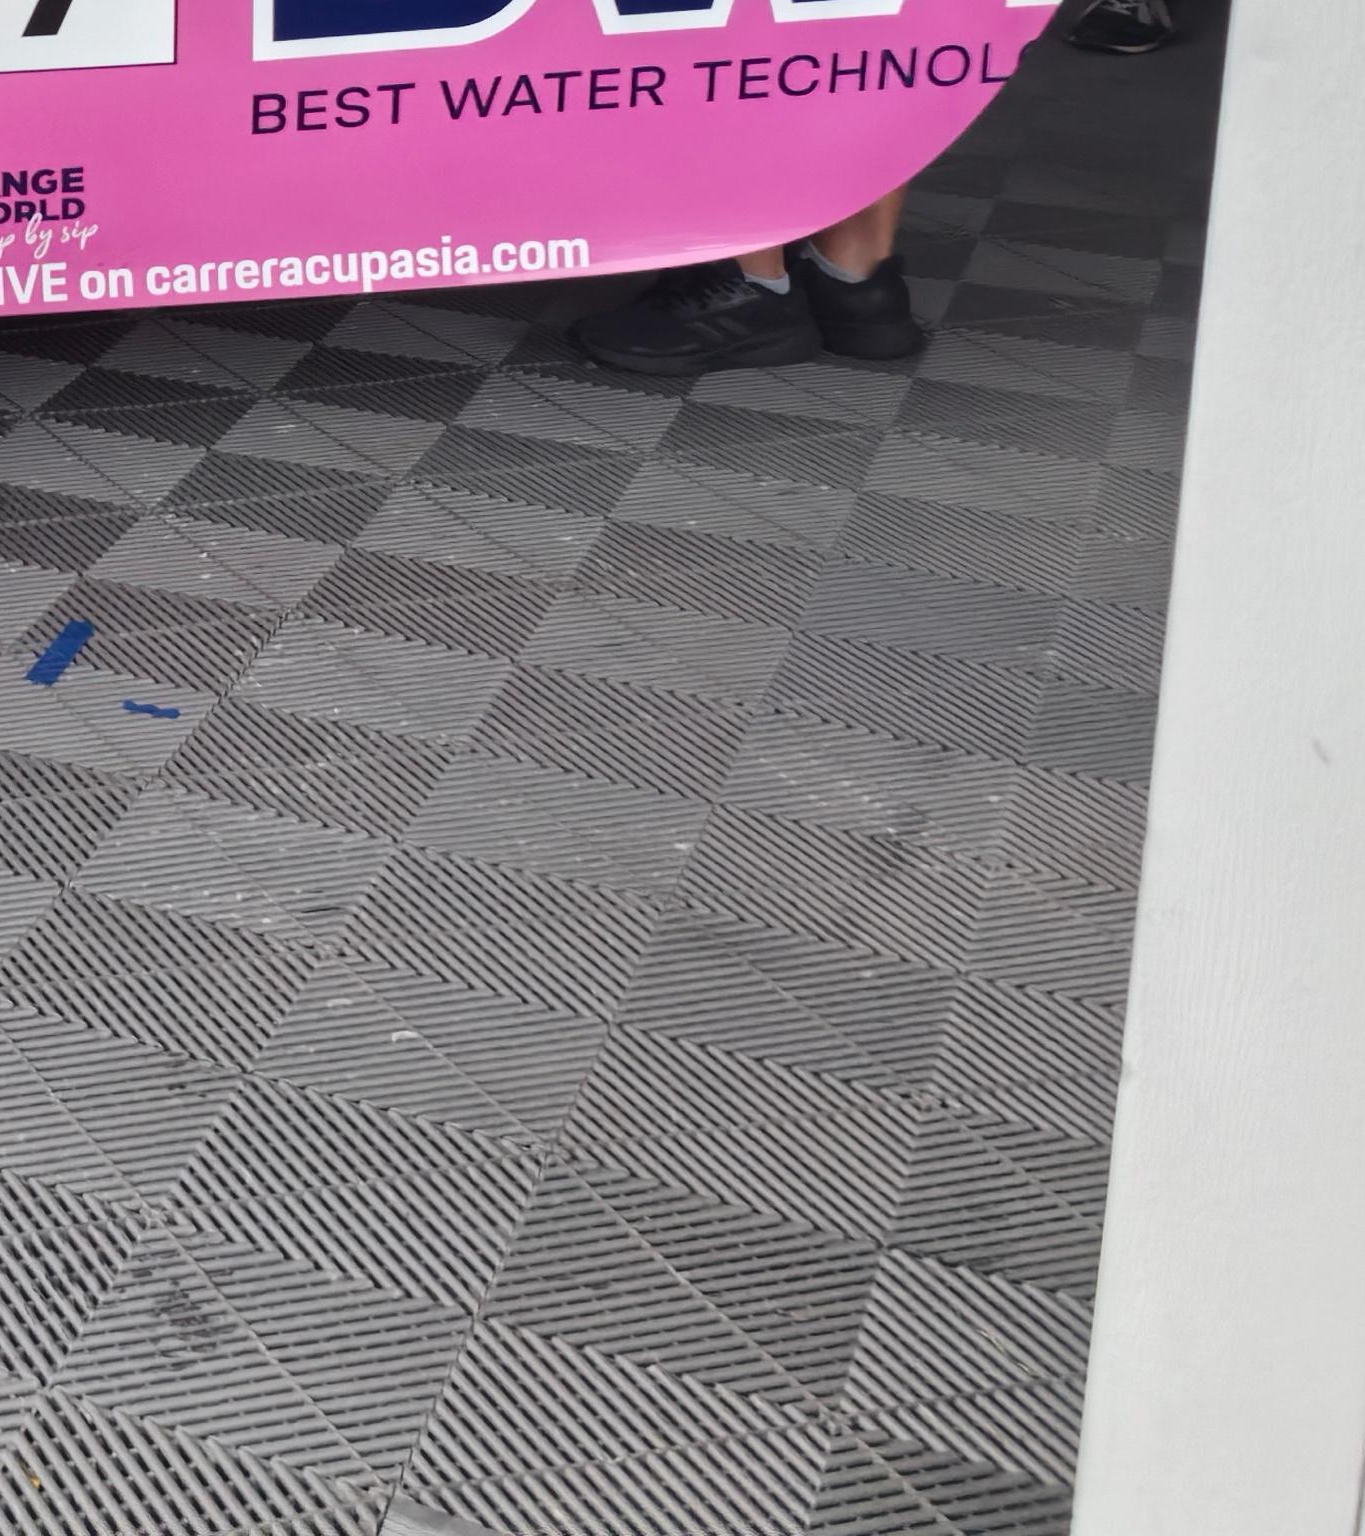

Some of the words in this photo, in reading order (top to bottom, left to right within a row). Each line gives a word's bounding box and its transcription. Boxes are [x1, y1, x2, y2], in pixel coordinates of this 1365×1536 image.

[251, 81, 416, 136] BEST
[442, 65, 667, 121] WATER
[24, 212, 53, 260] by
[60, 219, 99, 250] sip
[79, 268, 135, 300] on
[146, 234, 590, 294] carreracupasia.com
